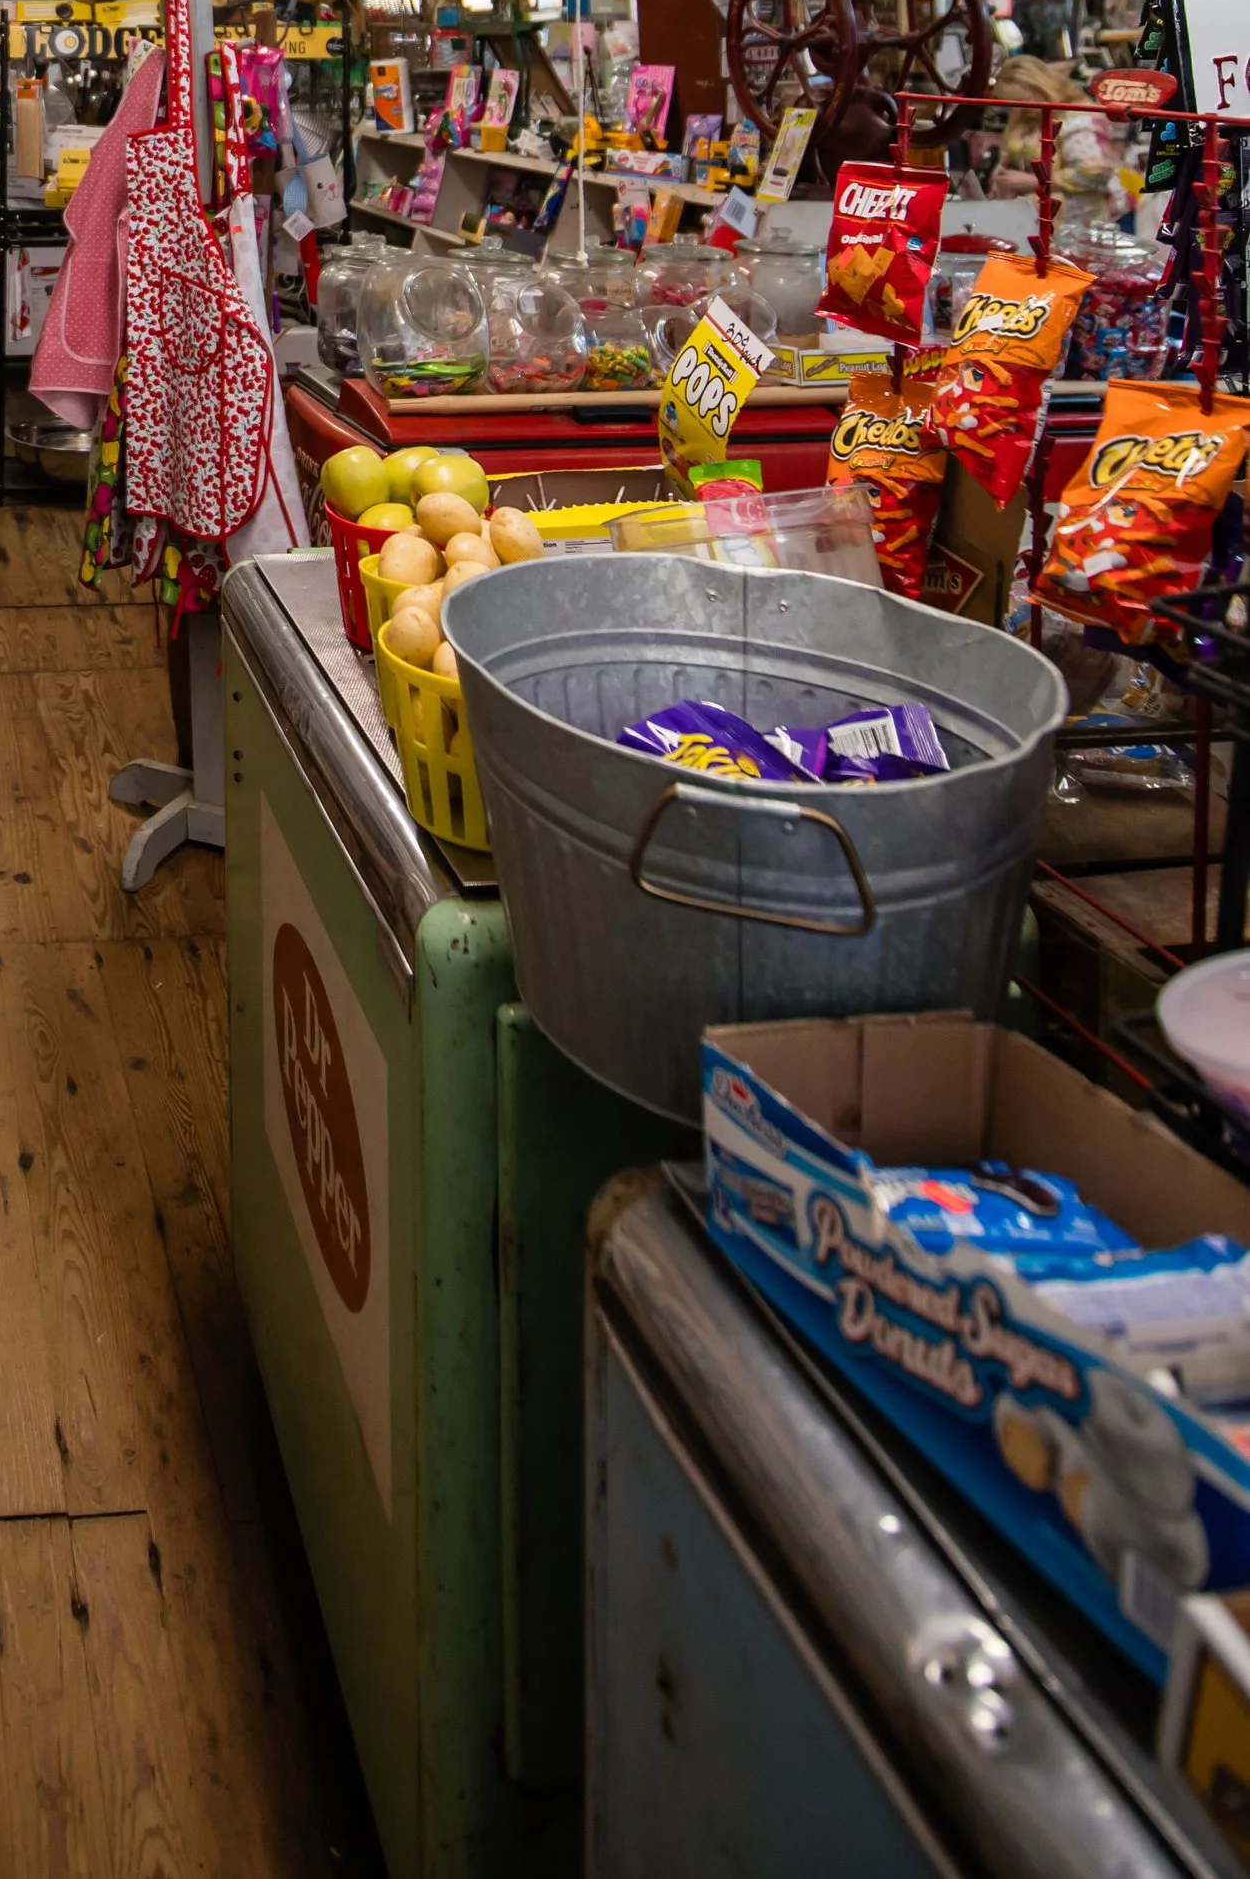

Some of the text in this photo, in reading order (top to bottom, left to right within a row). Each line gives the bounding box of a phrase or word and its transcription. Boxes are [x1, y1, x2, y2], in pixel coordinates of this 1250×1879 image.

[672, 345, 738, 438] POPS
[839, 362, 888, 373] Peanut Log
[303, 970, 332, 1099] Dr
[282, 985, 362, 1279] Pepper
[809, 1194, 963, 1327] Powdered
[963, 1285, 1081, 1400] Sugar
[838, 1276, 985, 1408] Donuts
